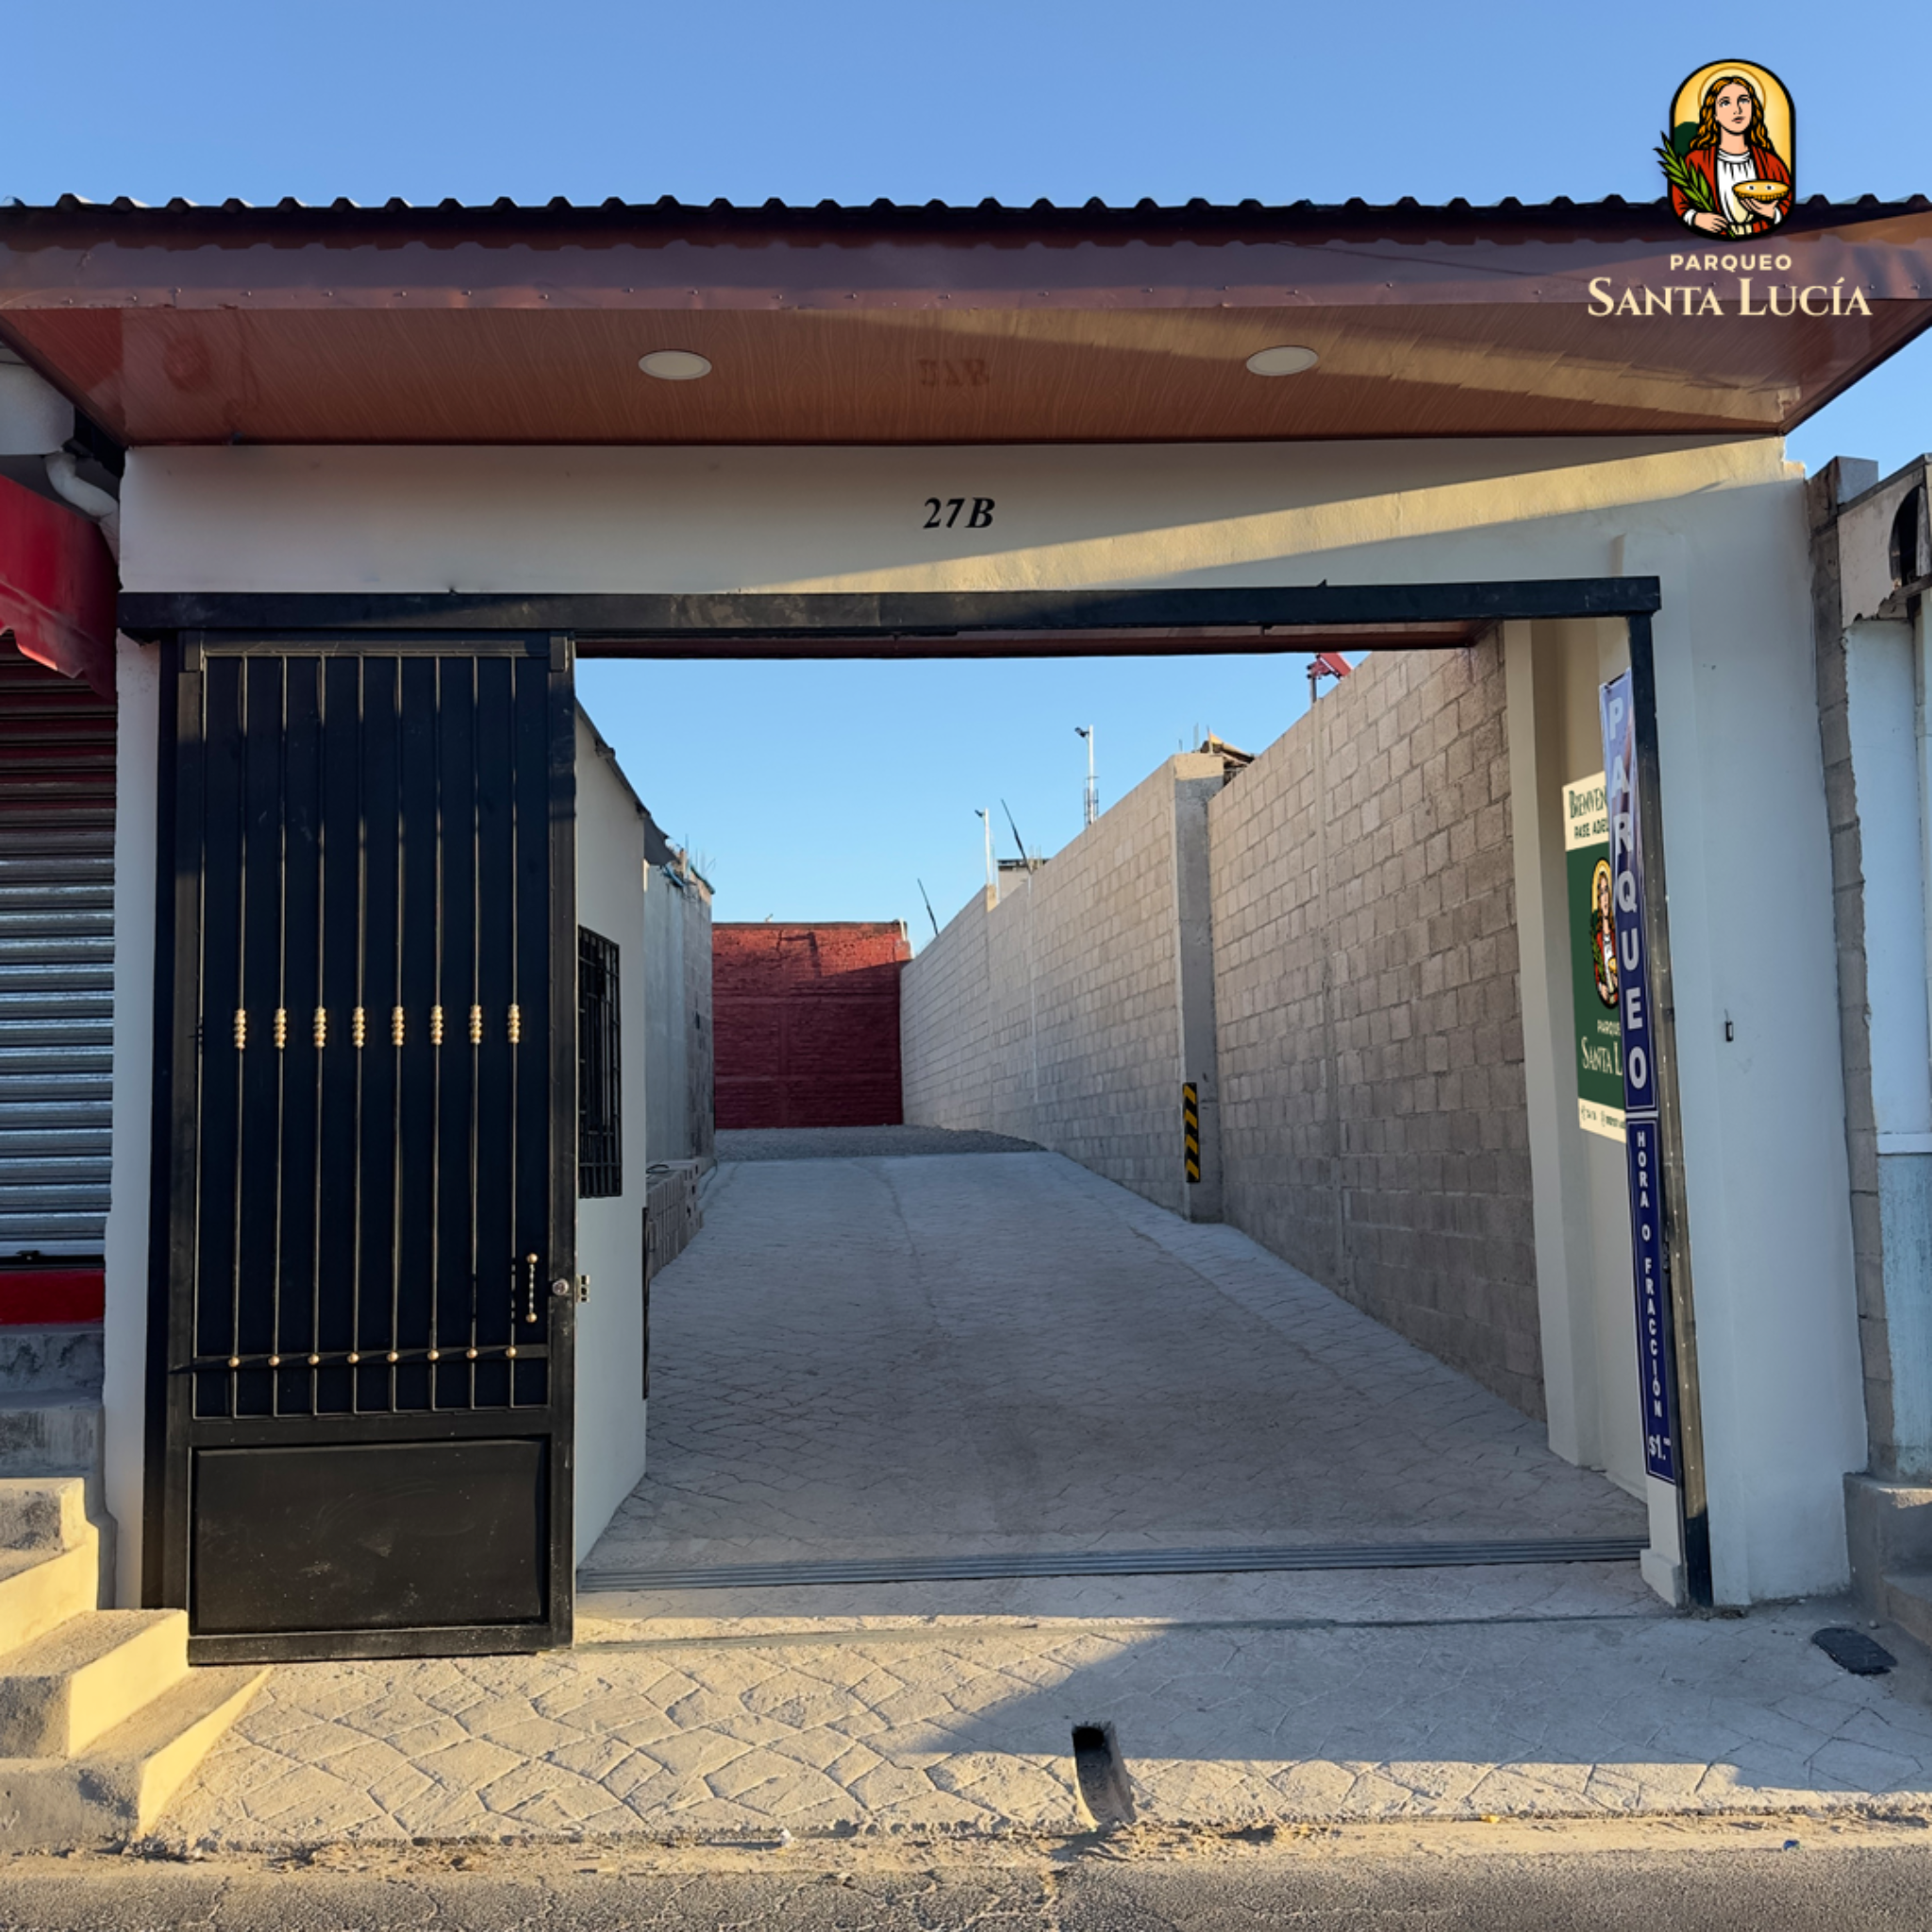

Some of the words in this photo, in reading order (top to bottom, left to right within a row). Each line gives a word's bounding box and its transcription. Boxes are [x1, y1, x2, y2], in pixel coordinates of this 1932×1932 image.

[923, 496, 995, 529] 27B
[1608, 696, 1647, 1090] PARQUEO
[1581, 1036, 1613, 1074] SANTA
[1637, 1130, 1649, 1208] HORA
[1641, 1224, 1651, 1241] O
